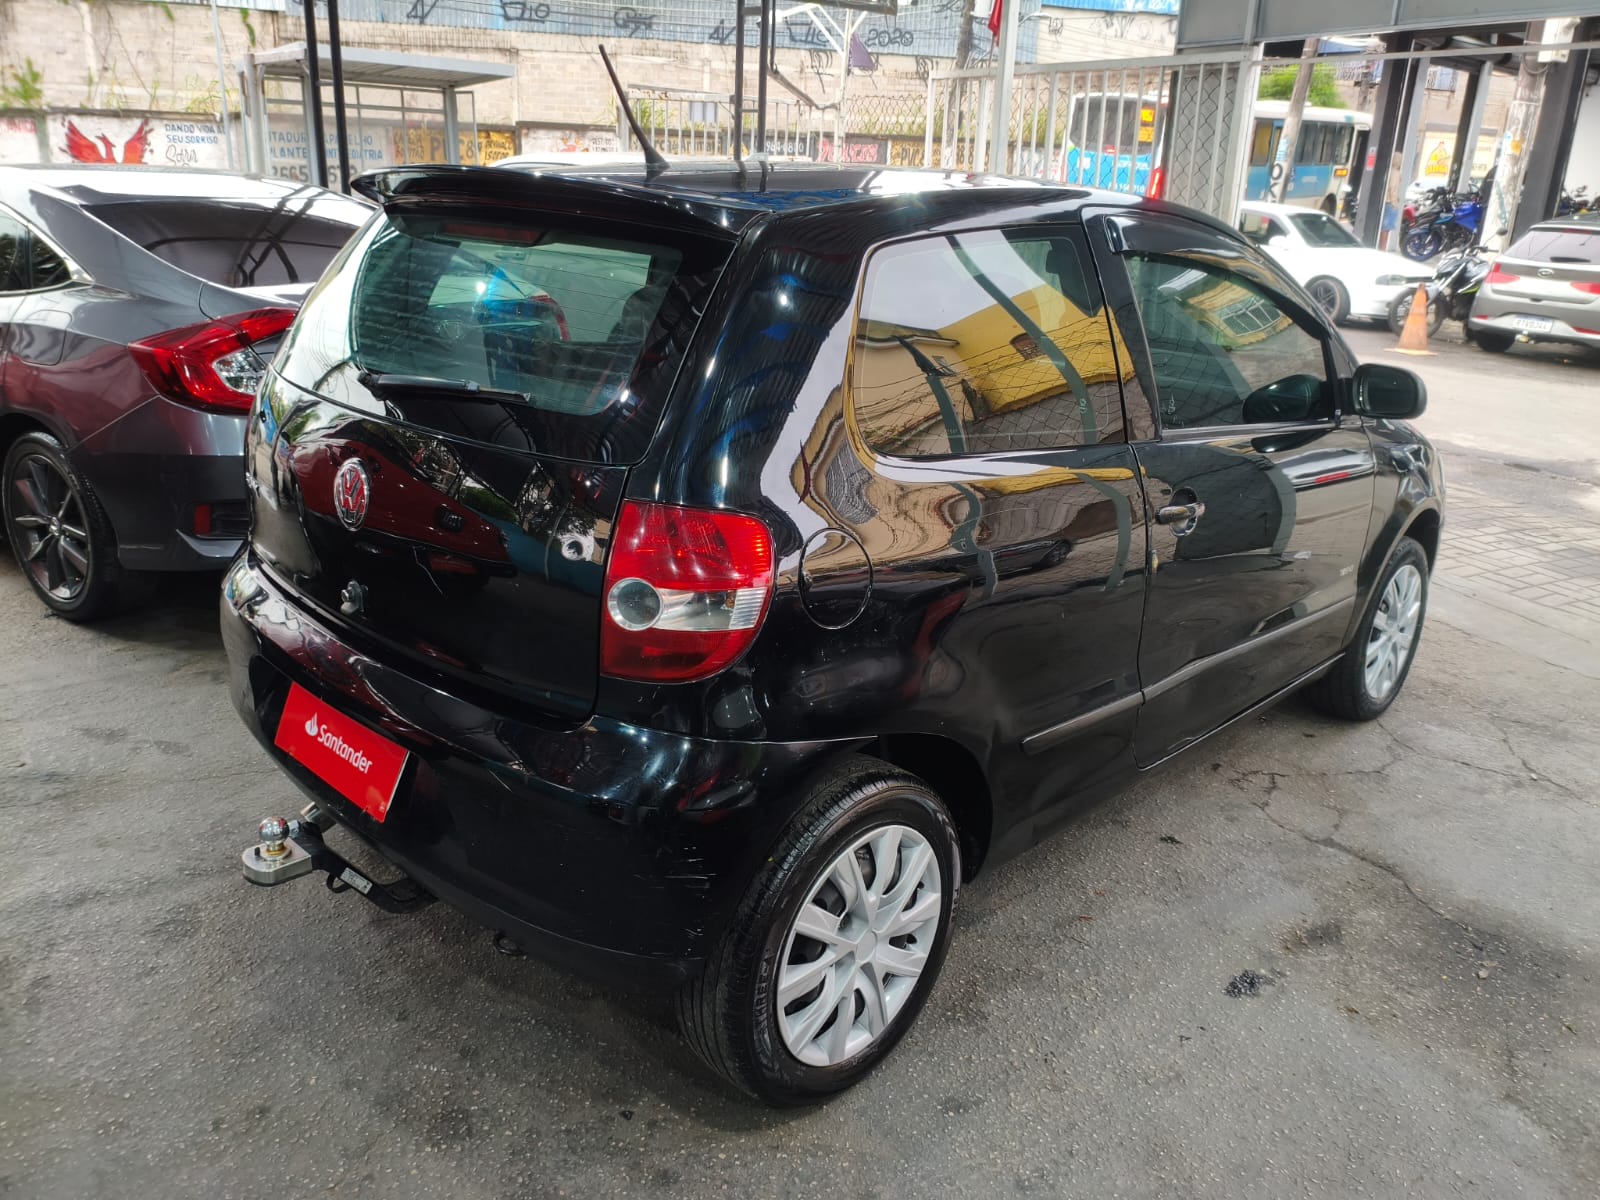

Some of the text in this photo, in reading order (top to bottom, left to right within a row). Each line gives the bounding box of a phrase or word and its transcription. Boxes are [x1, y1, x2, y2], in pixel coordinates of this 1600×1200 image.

[864, 28, 914, 47] 2020
[164, 123, 195, 134] DANDO
[166, 134, 184, 143] SEU
[317, 724, 373, 774] Santander
